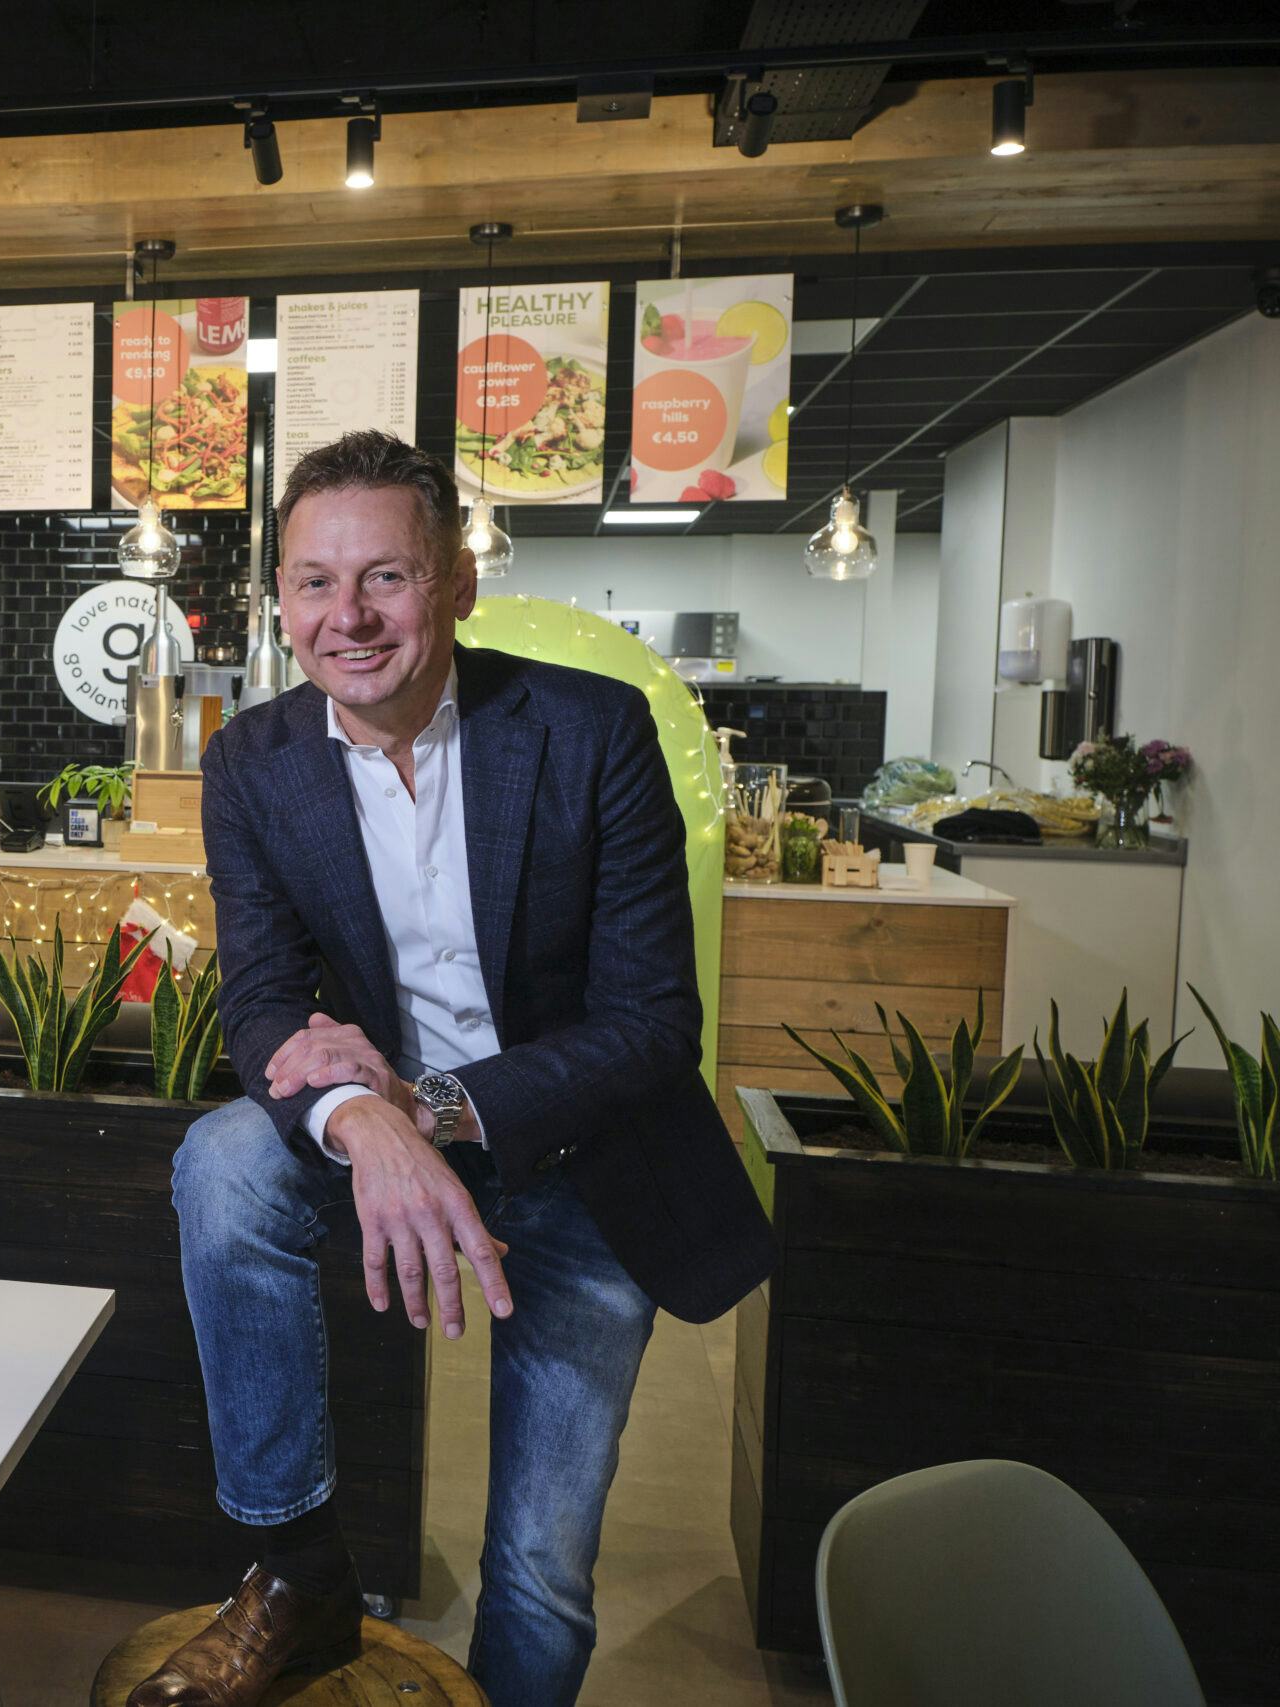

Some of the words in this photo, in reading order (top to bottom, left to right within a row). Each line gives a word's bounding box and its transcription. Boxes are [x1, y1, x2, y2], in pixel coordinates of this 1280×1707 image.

[288, 304, 325, 313] shakes
[337, 302, 368, 312] juices
[477, 292, 593, 314] HEALTHY
[490, 313, 577, 327] PLEASURE
[121, 336, 153, 348] ready
[158, 336, 171, 345] to
[121, 349, 171, 362] rendang
[287, 355, 326, 364] coffees
[463, 361, 536, 375] cauliflower
[478, 377, 520, 390] power
[476, 395, 520, 408] €9,25
[641, 397, 711, 411] raspberry
[662, 411, 689, 423] hills
[286, 431, 309, 439] teas
[651, 430, 699, 445] €4,50
[71, 600, 108, 632] love
[116, 596, 173, 634] natue
[102, 622, 145, 685] g
[63, 653, 82, 678] go
